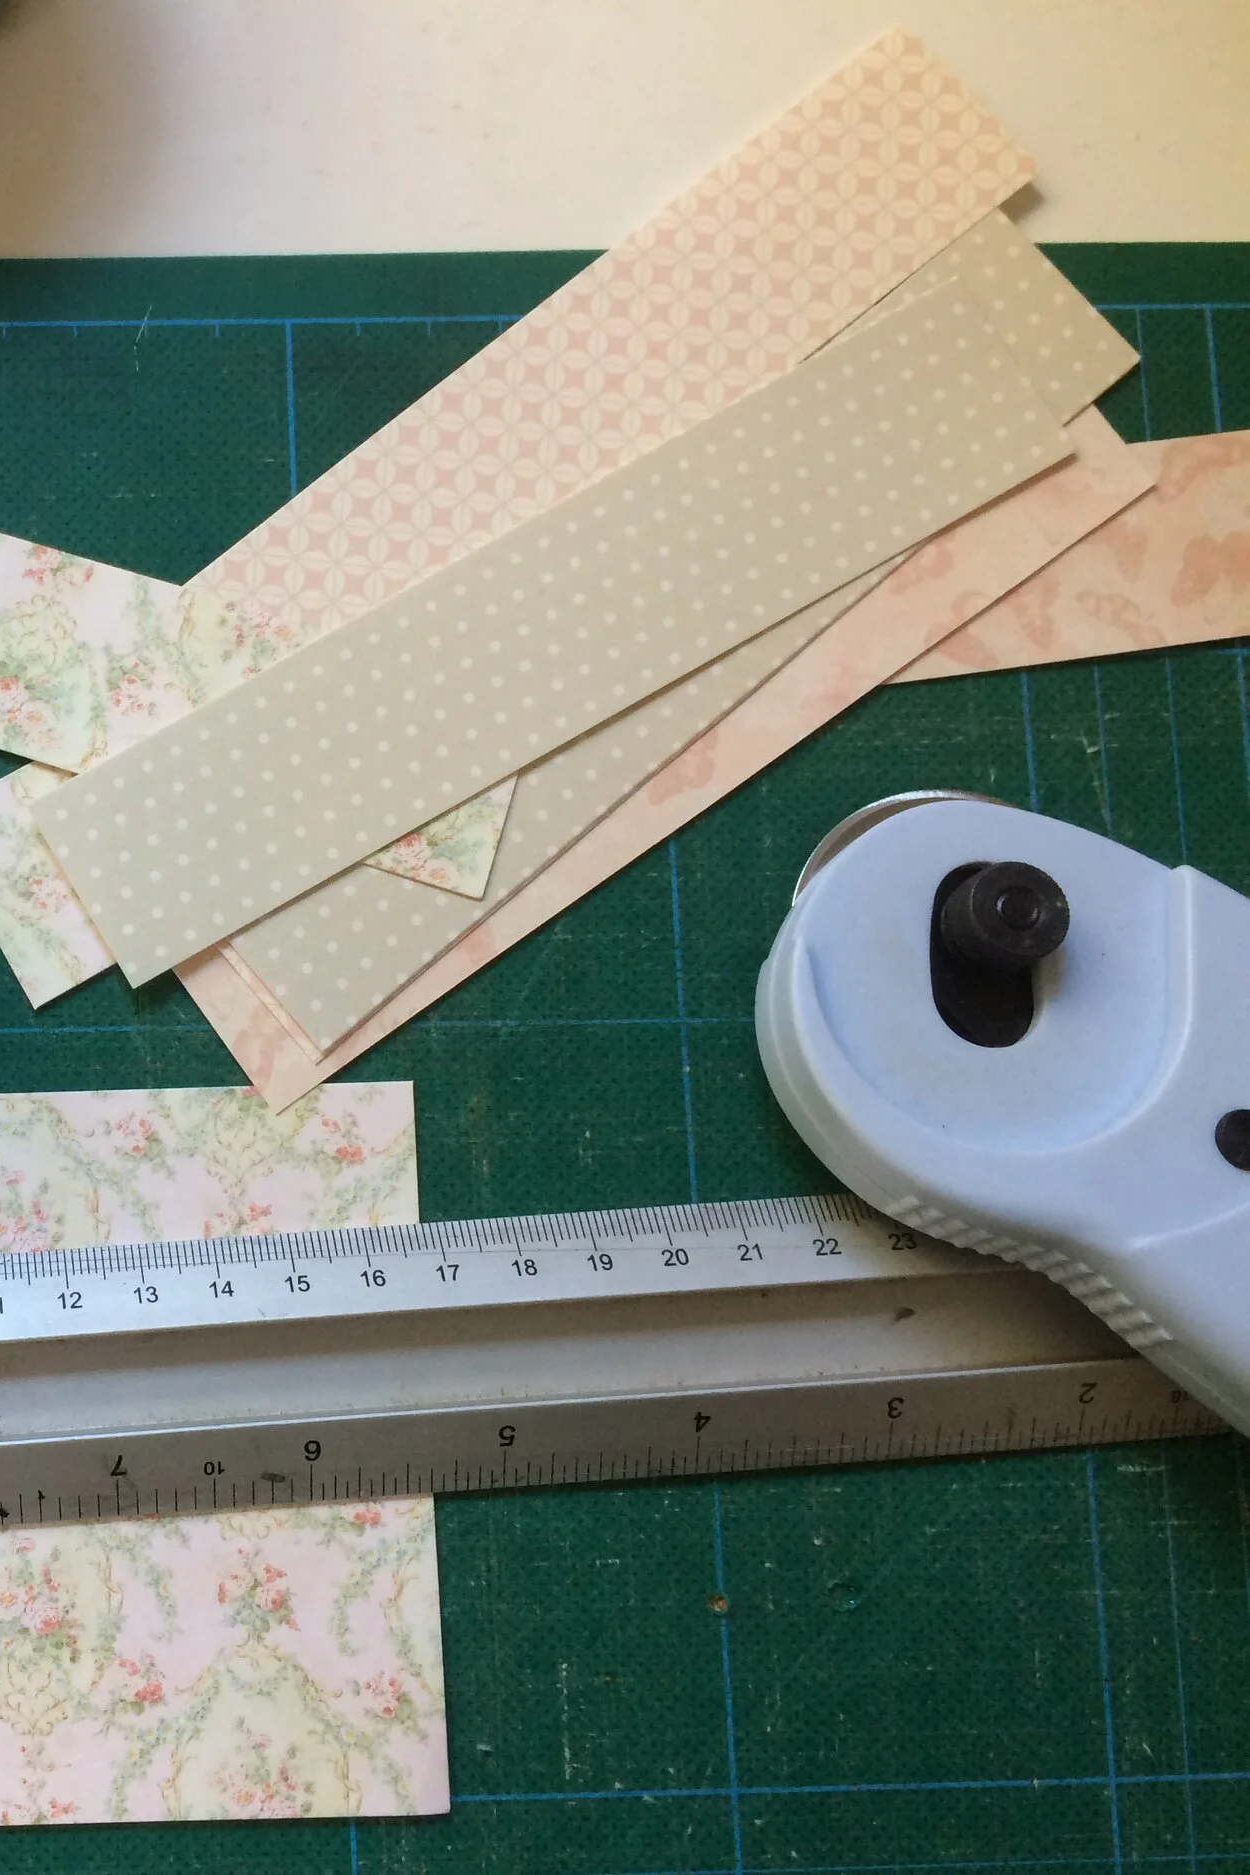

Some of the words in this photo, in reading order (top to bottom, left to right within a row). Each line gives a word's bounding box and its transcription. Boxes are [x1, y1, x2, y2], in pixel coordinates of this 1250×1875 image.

[57, 1291, 83, 1310] 12
[133, 1285, 159, 1304] 13
[209, 1280, 235, 1299] 14
[284, 1274, 311, 1293] 15
[360, 1269, 386, 1288] 16
[435, 1264, 460, 1282] 17
[511, 1258, 538, 1277] 18
[586, 1253, 613, 1272] 19
[661, 1248, 690, 1267] 20
[737, 1243, 763, 1262] 21
[812, 1237, 843, 1257] 22
[889, 1230, 918, 1252] 23
[1078, 1382, 1098, 1405] 2
[887, 1397, 905, 1420] 3
[693, 1411, 711, 1433] 4
[498, 1425, 516, 1448] 5
[303, 1440, 322, 1462] 6
[110, 1454, 128, 1477] 7
[203, 1460, 225, 1476] 10
